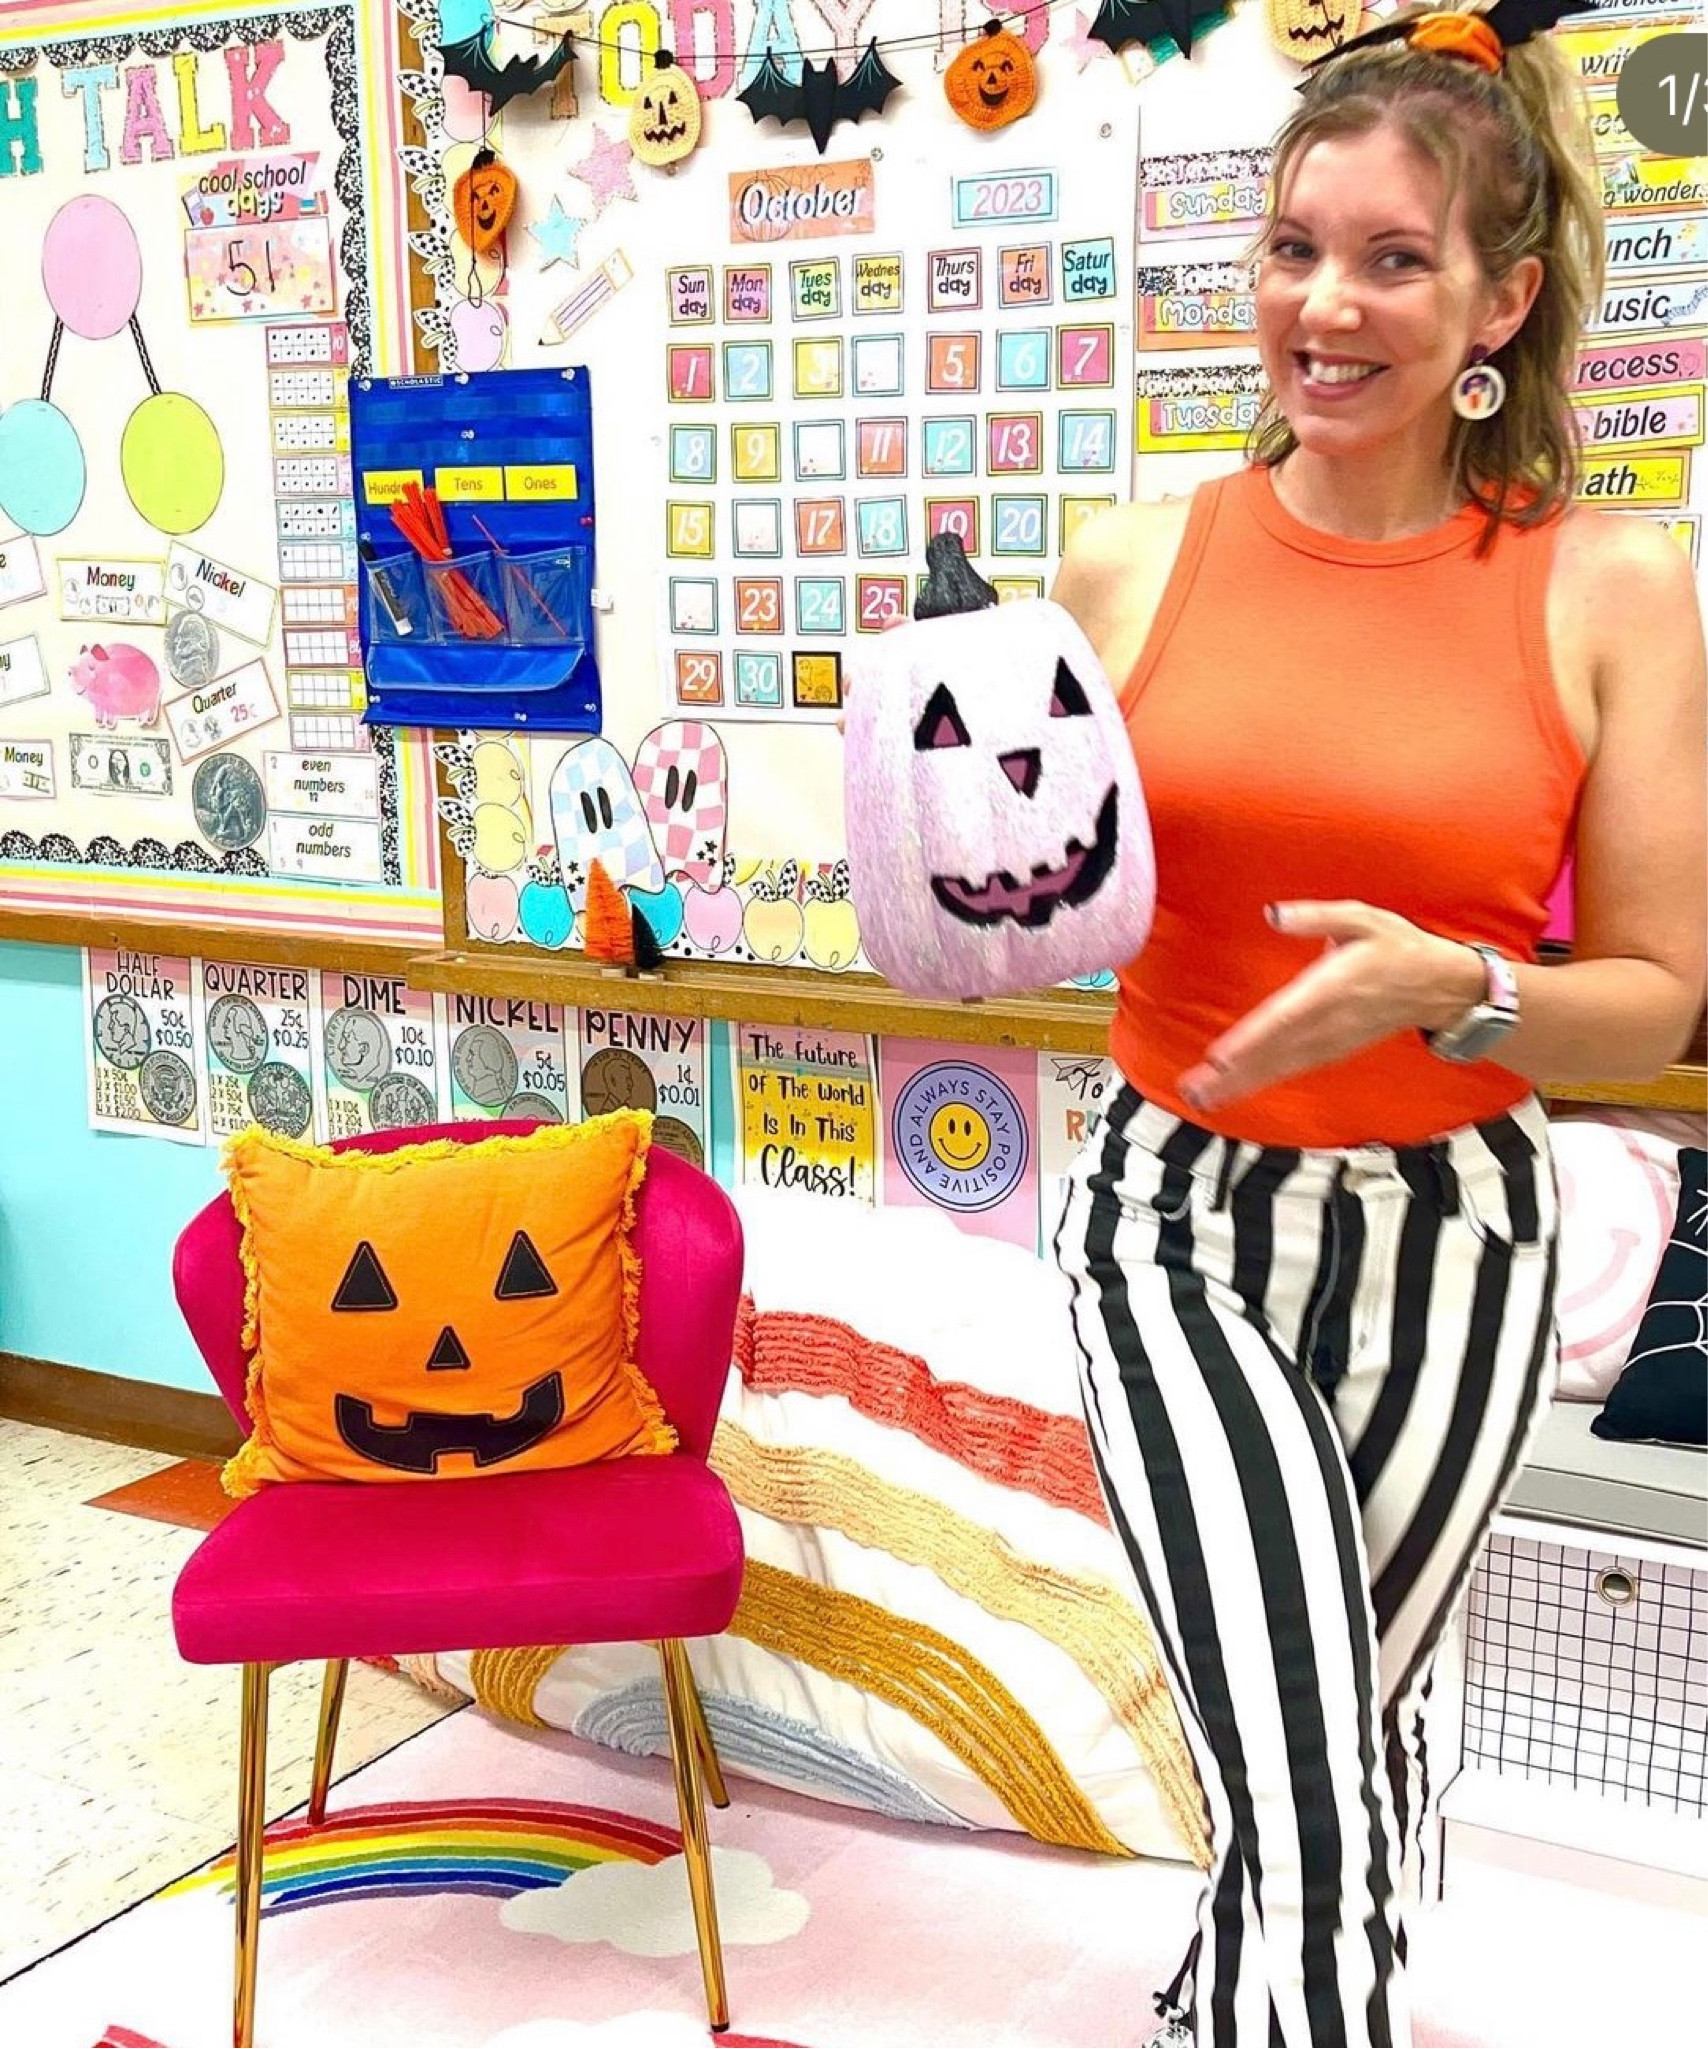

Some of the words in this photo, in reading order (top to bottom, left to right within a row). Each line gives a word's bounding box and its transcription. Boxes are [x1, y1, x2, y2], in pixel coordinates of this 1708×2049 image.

[62, 39, 291, 173] TALK
[199, 168, 237, 194] cool
[243, 160, 306, 190] school
[228, 186, 285, 222] days
[738, 181, 865, 223] October
[973, 180, 1043, 217] 2023
[1170, 184, 1267, 219] Sunday
[227, 240, 275, 296] 51
[936, 257, 975, 276] Thurs
[1016, 253, 1035, 273] Fri
[1064, 249, 1111, 272] Satur
[678, 275, 705, 294] Sun
[731, 273, 764, 293] Mon
[800, 268, 832, 288] Tues
[861, 280, 892, 299] day
[939, 277, 970, 296] day
[1010, 276, 1042, 295] day
[1071, 274, 1107, 295] day
[679, 299, 707, 317] day
[732, 296, 761, 313] day
[801, 287, 831, 306] day
[739, 352, 760, 393] 2
[942, 345, 965, 385] 5
[1013, 340, 1036, 380] 6
[1073, 336, 1099, 377] 7
[1578, 352, 1680, 384] recess
[684, 355, 699, 394] 1
[1593, 406, 1667, 439] bible
[686, 435, 706, 471] 8
[746, 434, 768, 469] 9
[870, 427, 892, 462] 11
[935, 428, 966, 465] 12
[1000, 424, 1030, 461] 13
[1071, 423, 1106, 462] 14
[454, 477, 483, 491] Tens
[524, 475, 557, 491] Ones
[677, 510, 704, 546] 15
[807, 508, 835, 545] 17
[869, 508, 897, 545] 18
[1000, 508, 1042, 544] 20
[87, 566, 136, 591] Money
[195, 559, 246, 597] Nickel
[741, 590, 777, 622] 23
[804, 589, 839, 623] 24
[863, 585, 901, 620] 25
[682, 658, 716, 693] 29
[741, 659, 777, 691] 30
[192, 682, 237, 714] Quarter
[5, 746, 44, 766] Money
[301, 760, 332, 772] even
[294, 778, 346, 793] numbers
[308, 822, 334, 838] odd
[296, 841, 352, 858] numbers
[117, 951, 161, 976] HALF
[106, 973, 174, 1000] DOLLAR
[205, 964, 307, 1001] QUARTER
[343, 975, 407, 1016] DIME
[161, 1009, 186, 1029] 50¢
[281, 1009, 304, 1029] 25¢
[456, 997, 558, 1033] NICKEL
[156, 1029, 193, 1049] $0.50
[273, 1030, 309, 1049] $0.25
[401, 1026, 426, 1046] 10¢
[586, 1009, 696, 1054] PENNY
[748, 1032, 783, 1060] The
[395, 1046, 434, 1067] $0.10
[535, 1050, 555, 1071] 5¢
[523, 1070, 565, 1092] $0.05
[677, 1064, 693, 1085] 1¢
[777, 1075, 808, 1100] The
[818, 1082, 864, 1106] World
[658, 1084, 700, 1106] $0.01
[910, 1080, 970, 1126] ALWAYS
[764, 1115, 778, 1135] Is
[790, 1113, 806, 1136] In
[815, 1116, 855, 1142] This
[974, 1089, 1011, 1134] STAY
[910, 1133, 938, 1174] AND
[939, 1142, 1011, 1193] POSITIVE
[760, 1143, 856, 1197] Class!
